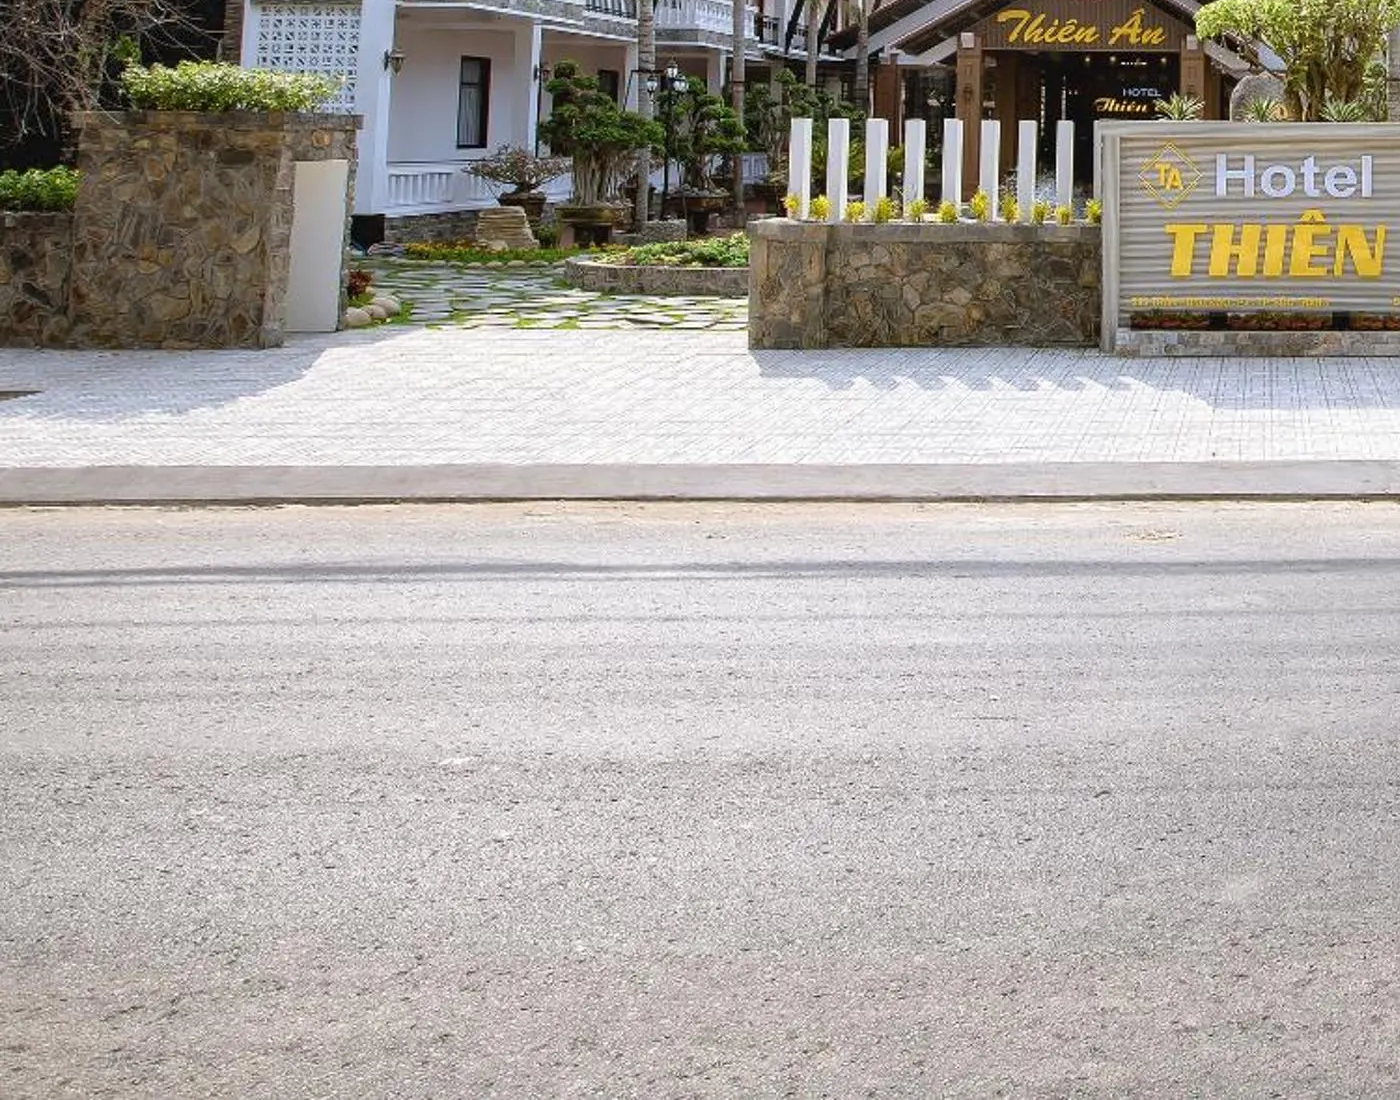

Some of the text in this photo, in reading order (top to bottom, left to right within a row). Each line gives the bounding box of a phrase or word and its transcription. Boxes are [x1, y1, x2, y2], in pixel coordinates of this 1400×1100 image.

[997, 7, 1166, 45] Thiên Ân
[1122, 88, 1163, 97] HOTEL
[1155, 162, 1183, 191] TA
[1215, 153, 1374, 198] Hotel
[1164, 208, 1386, 278] THIÊN
